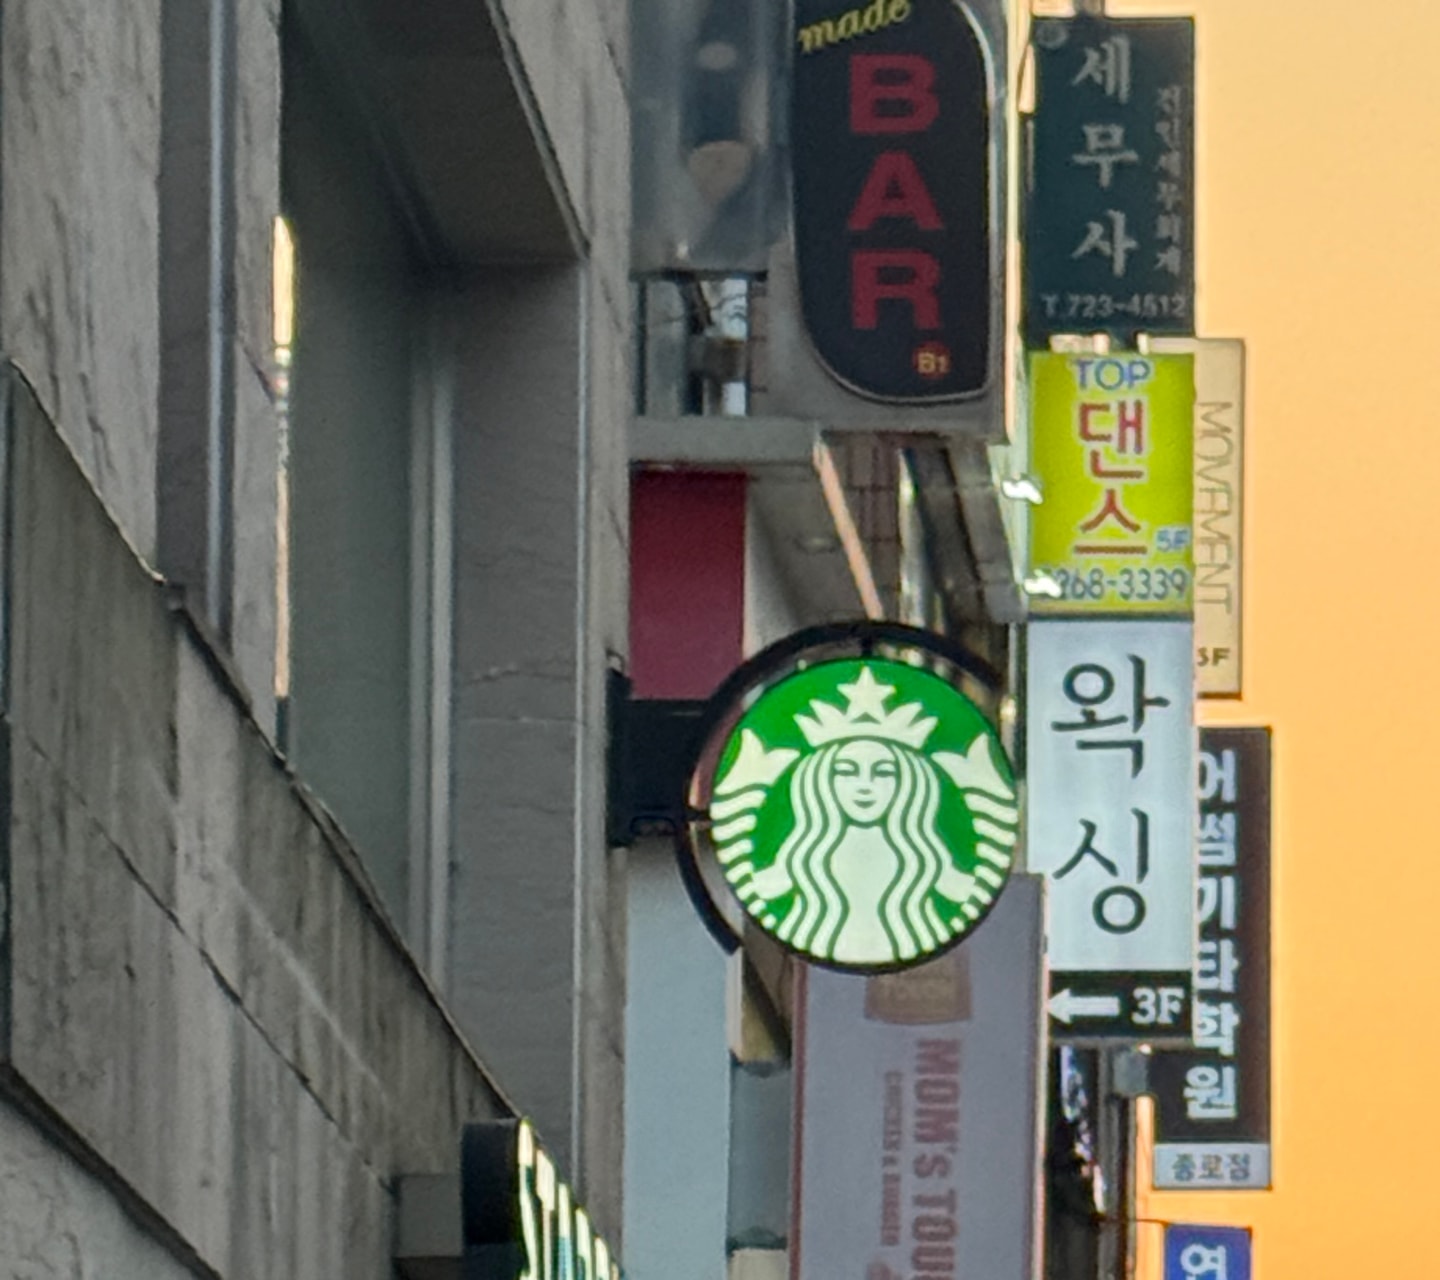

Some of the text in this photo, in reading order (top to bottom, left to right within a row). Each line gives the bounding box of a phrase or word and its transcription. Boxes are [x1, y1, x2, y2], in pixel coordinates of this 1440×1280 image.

[799, 0, 911, 51] made
[848, 55, 944, 330] BAR
[1071, 34, 1139, 278] 세무사
[918, 353, 949, 374] B1
[1074, 359, 1150, 391] TOP
[1074, 398, 1148, 555] 댄스
[1156, 529, 1190, 551] 5F
[1196, 401, 1233, 615] MOVEMENT
[1051, 653, 1171, 935] 왁싱
[1184, 748, 1240, 1120] 어썸기타학원
[1131, 987, 1185, 1026] 3F
[912, 1038, 962, 1180] MOM'S
[1171, 1152, 1252, 1182] 종로점
